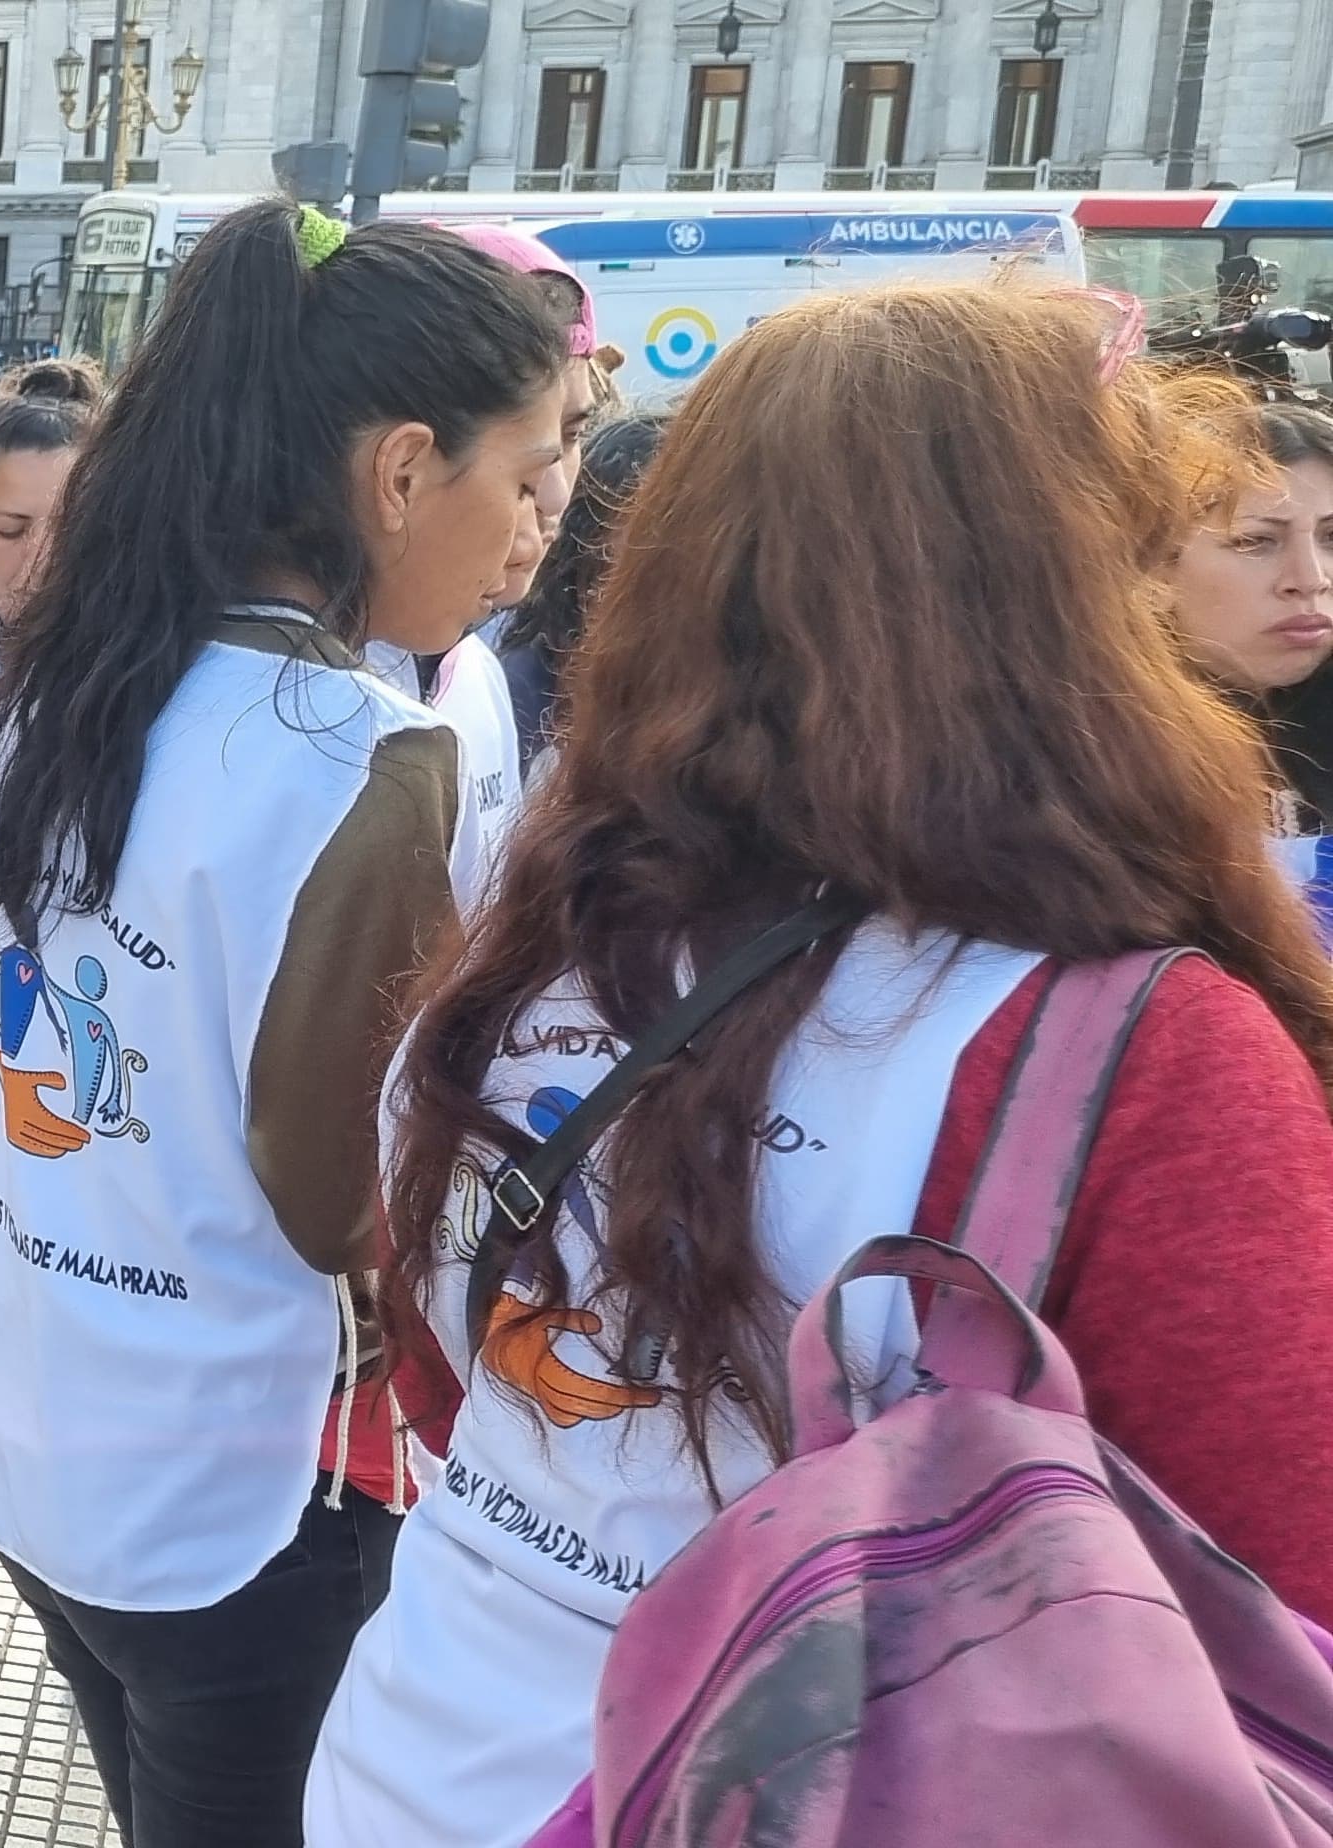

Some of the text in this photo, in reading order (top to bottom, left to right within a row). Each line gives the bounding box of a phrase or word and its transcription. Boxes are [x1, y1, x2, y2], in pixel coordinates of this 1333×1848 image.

[830, 219, 1013, 242] AMBULANCIA
[33, 1237, 56, 1270] DE
[55, 1246, 118, 1289] MALA
[121, 1265, 188, 1300] PRAXIS
[445, 1448, 468, 1498] ARES
[467, 1472, 487, 1507] Y
[553, 1528, 589, 1571] DE
[581, 1547, 646, 1594] MALA
